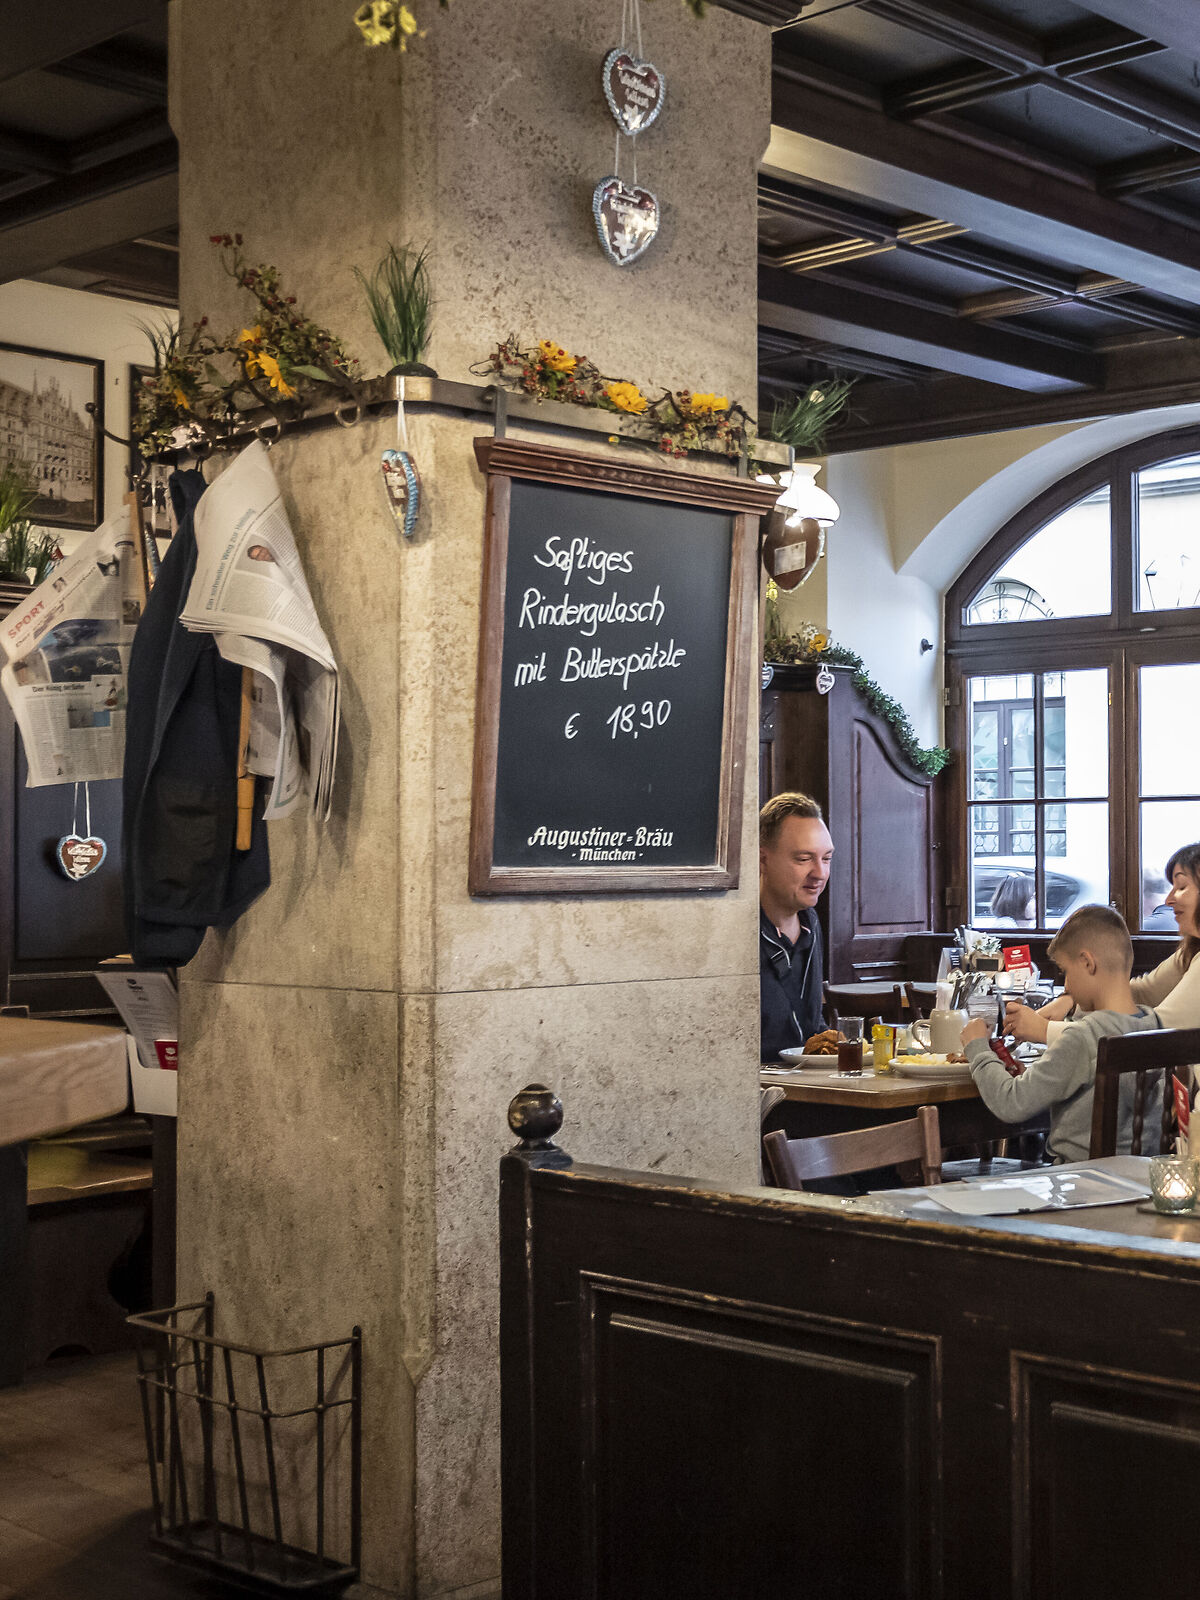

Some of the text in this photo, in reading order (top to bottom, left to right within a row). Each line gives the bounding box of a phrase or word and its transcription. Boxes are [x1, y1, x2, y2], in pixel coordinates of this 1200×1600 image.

[205, 596, 215, 611] Ein
[221, 543, 236, 562] Weg
[534, 536, 634, 586] Saftiges
[8, 599, 48, 640] SPORT
[518, 585, 666, 637] Rindergulasch
[514, 639, 687, 691] mit Butterspätzle
[564, 699, 672, 739] € 18,90
[579, 848, 637, 861] München
